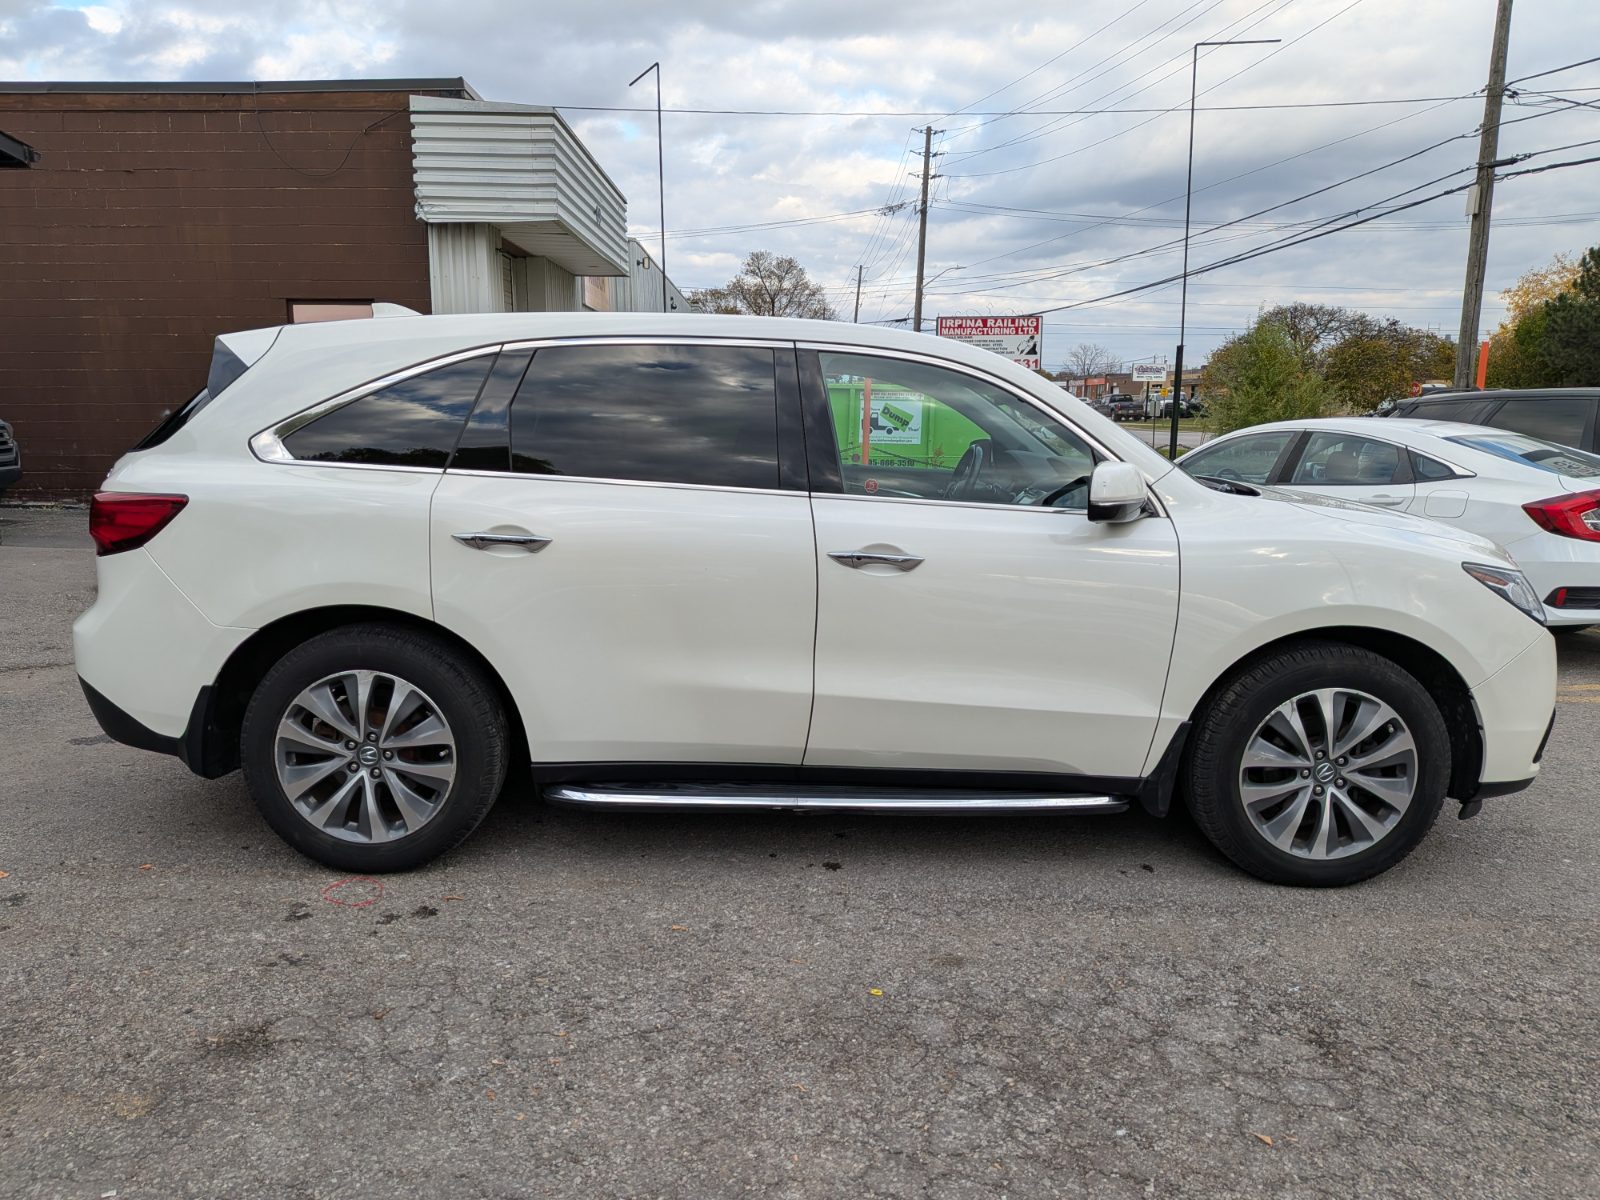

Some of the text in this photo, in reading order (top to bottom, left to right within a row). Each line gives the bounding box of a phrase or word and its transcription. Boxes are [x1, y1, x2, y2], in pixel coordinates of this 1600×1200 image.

[942, 318, 1037, 327] IRPINA RAILING
[941, 327, 1016, 335] MANUFACTURING
[881, 406, 910, 427] Dump
